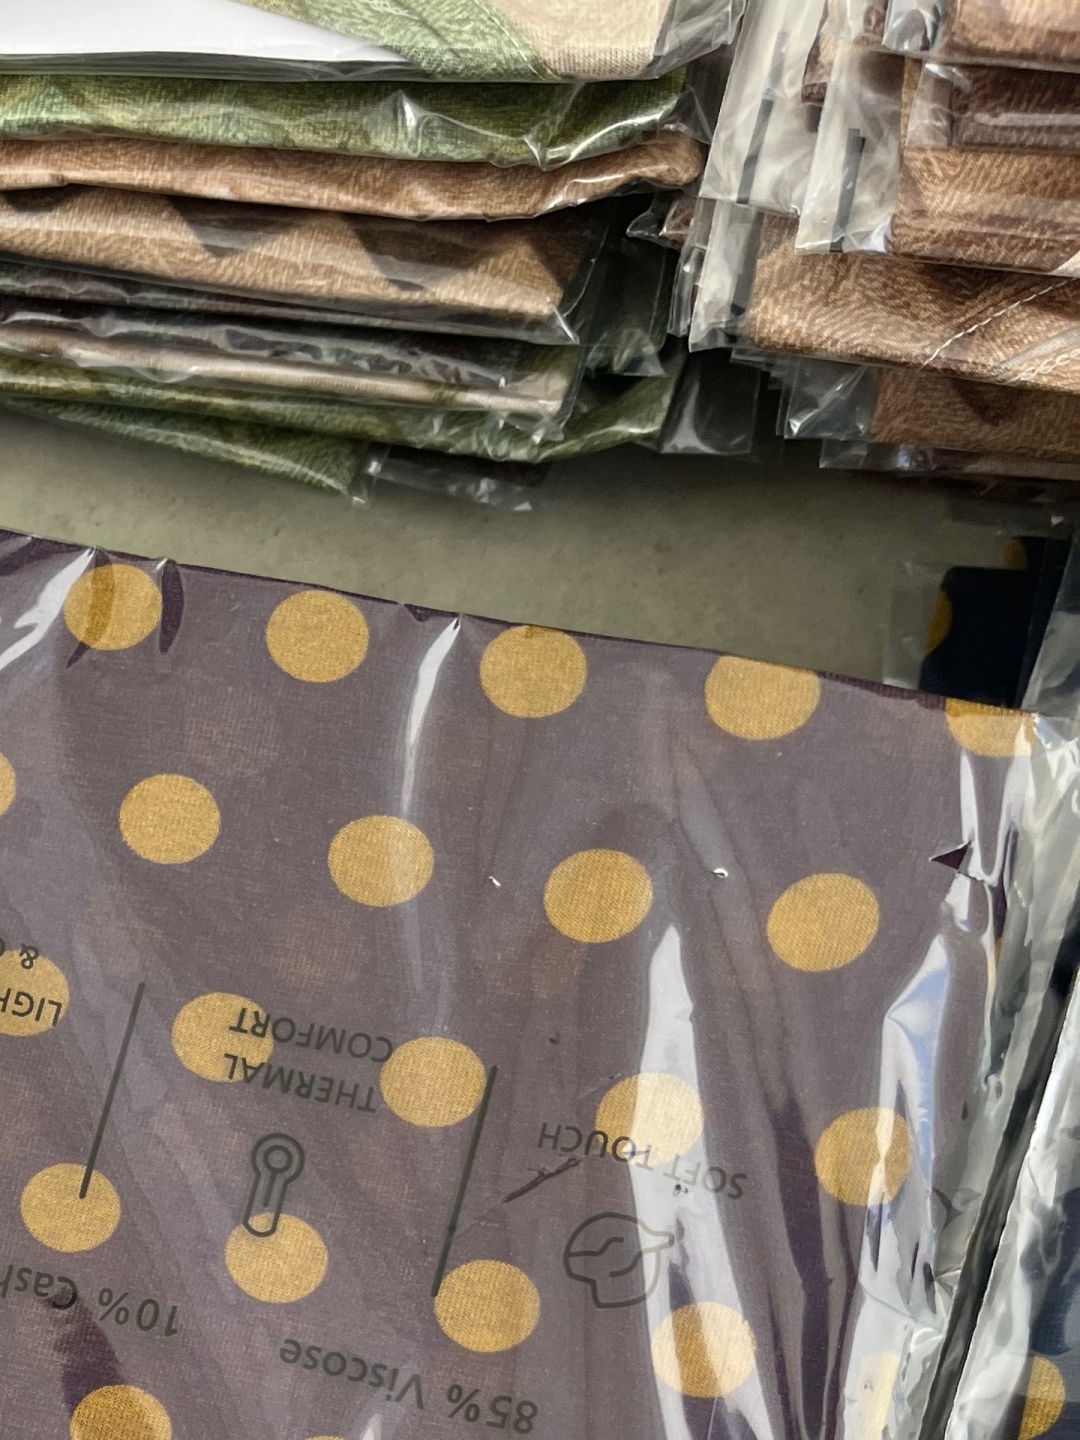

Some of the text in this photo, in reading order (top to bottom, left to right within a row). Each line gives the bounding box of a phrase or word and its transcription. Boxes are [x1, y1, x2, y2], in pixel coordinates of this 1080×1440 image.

[19, 943, 39, 969] &
[228, 1007, 393, 1063] COMFORT
[224, 1053, 376, 1113] THERMAL
[537, 1122, 747, 1200] SOFT TOUCH
[98, 1287, 178, 1336] 10%
[279, 1338, 538, 1434] 85% Viscose
